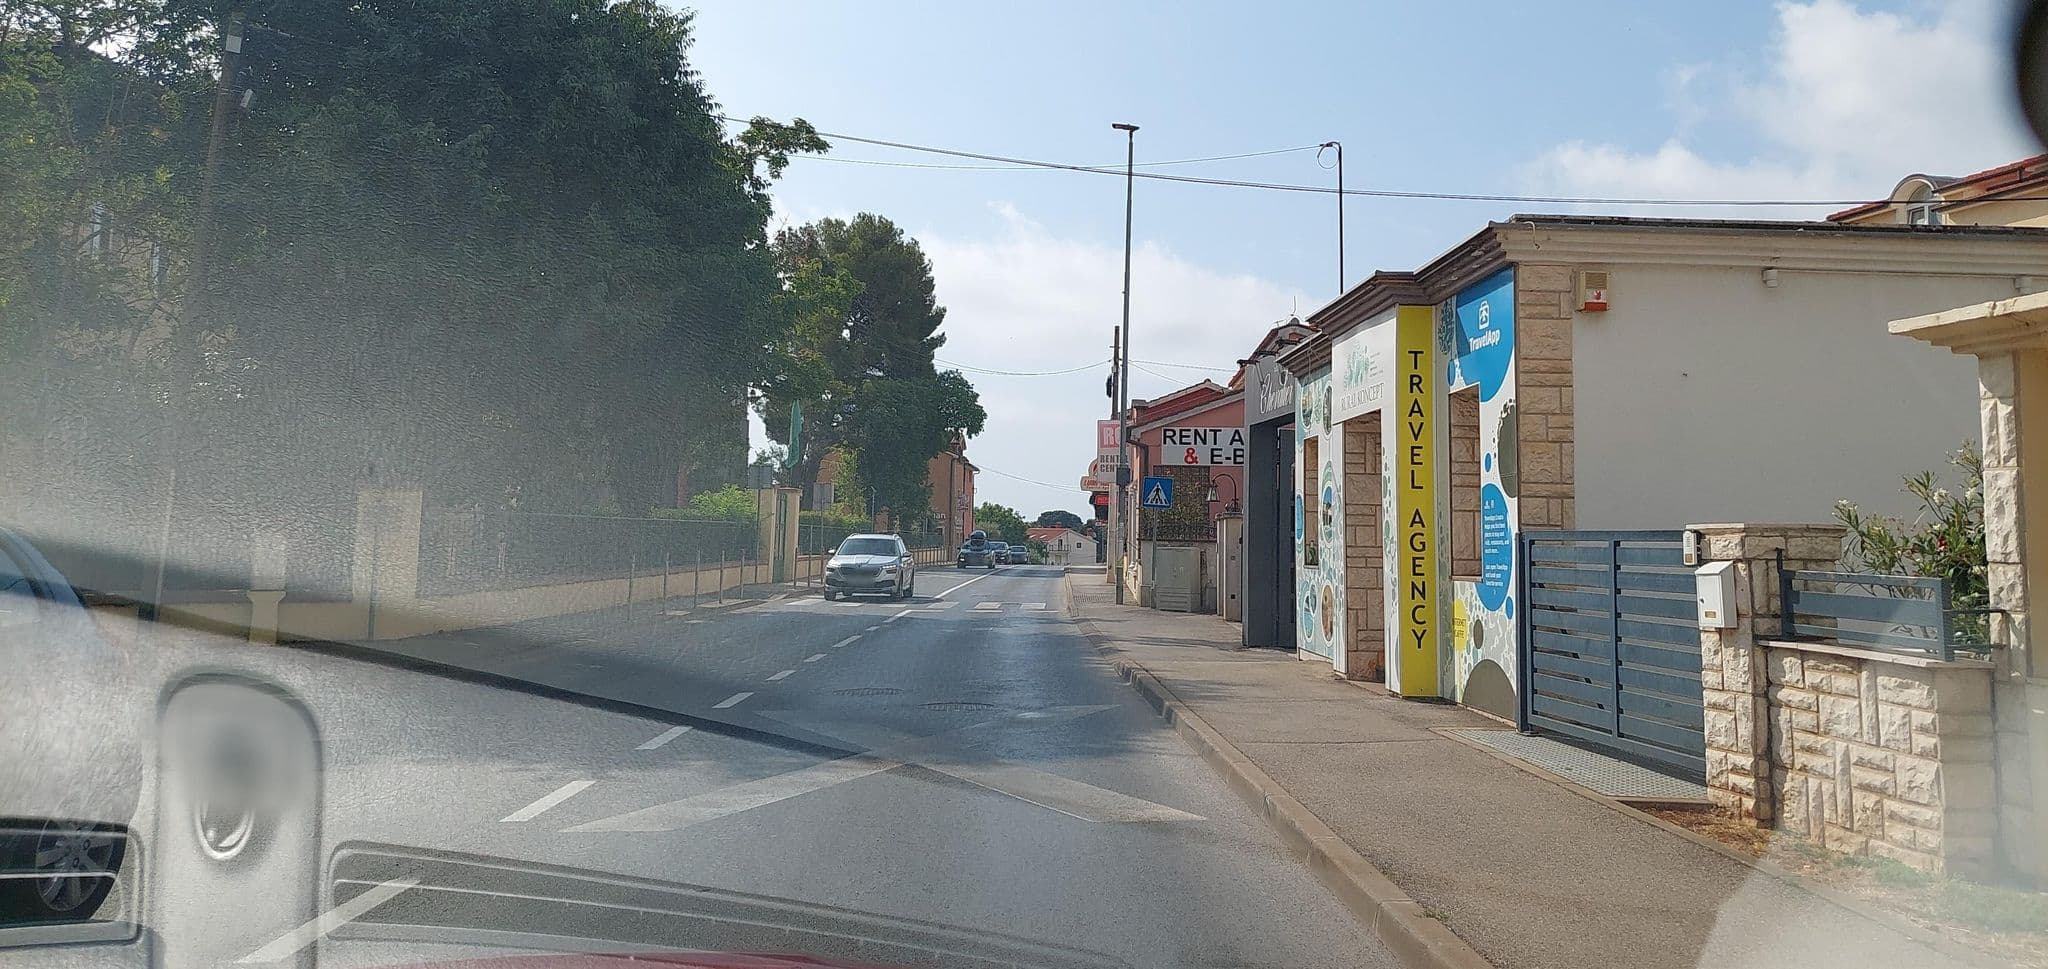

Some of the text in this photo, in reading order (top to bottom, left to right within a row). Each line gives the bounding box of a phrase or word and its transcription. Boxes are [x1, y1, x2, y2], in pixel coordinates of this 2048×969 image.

[1469, 329, 1501, 353] TravelApp
[1163, 428, 1222, 446] RENT
[1184, 447, 1245, 465] & E-B
[1407, 349, 1427, 649] TRAVEL AGENCY
